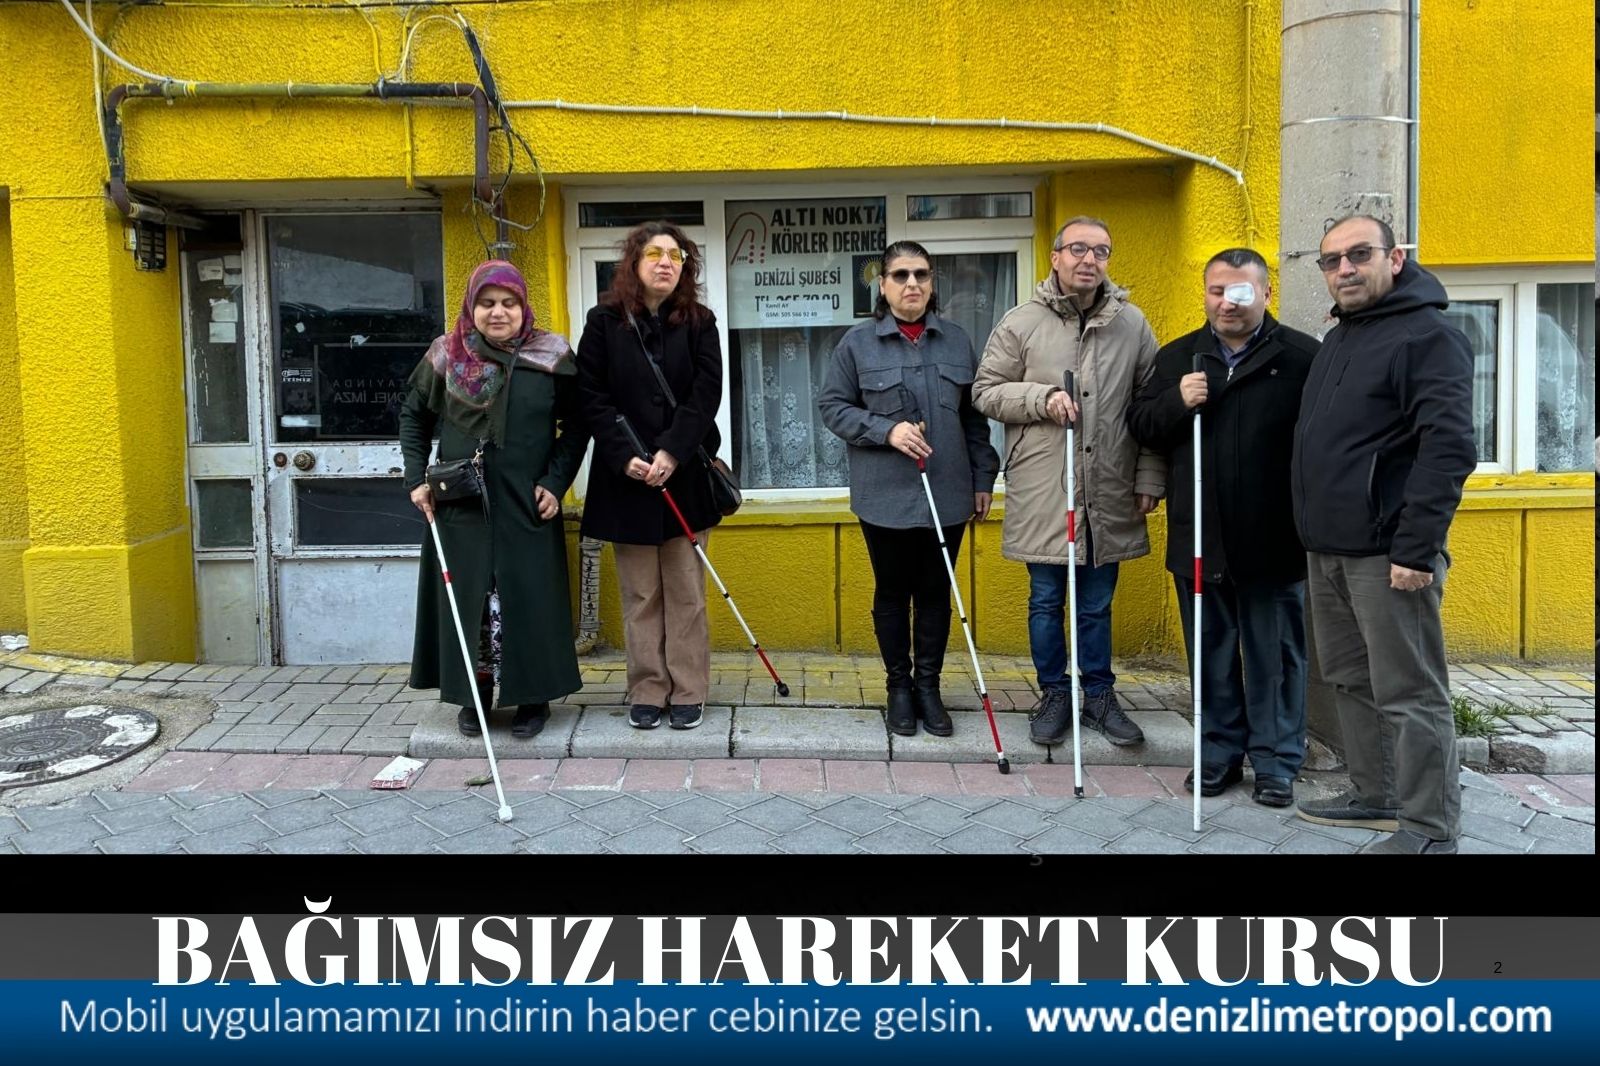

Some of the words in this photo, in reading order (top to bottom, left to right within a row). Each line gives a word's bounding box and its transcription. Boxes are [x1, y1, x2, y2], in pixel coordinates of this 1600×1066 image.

[770, 207, 816, 227] ALTI
[822, 205, 886, 226] NOKTA
[771, 228, 829, 255] KÖRLER
[754, 268, 795, 287] DENİZLİ
[799, 267, 841, 288] ŞUBESİ
